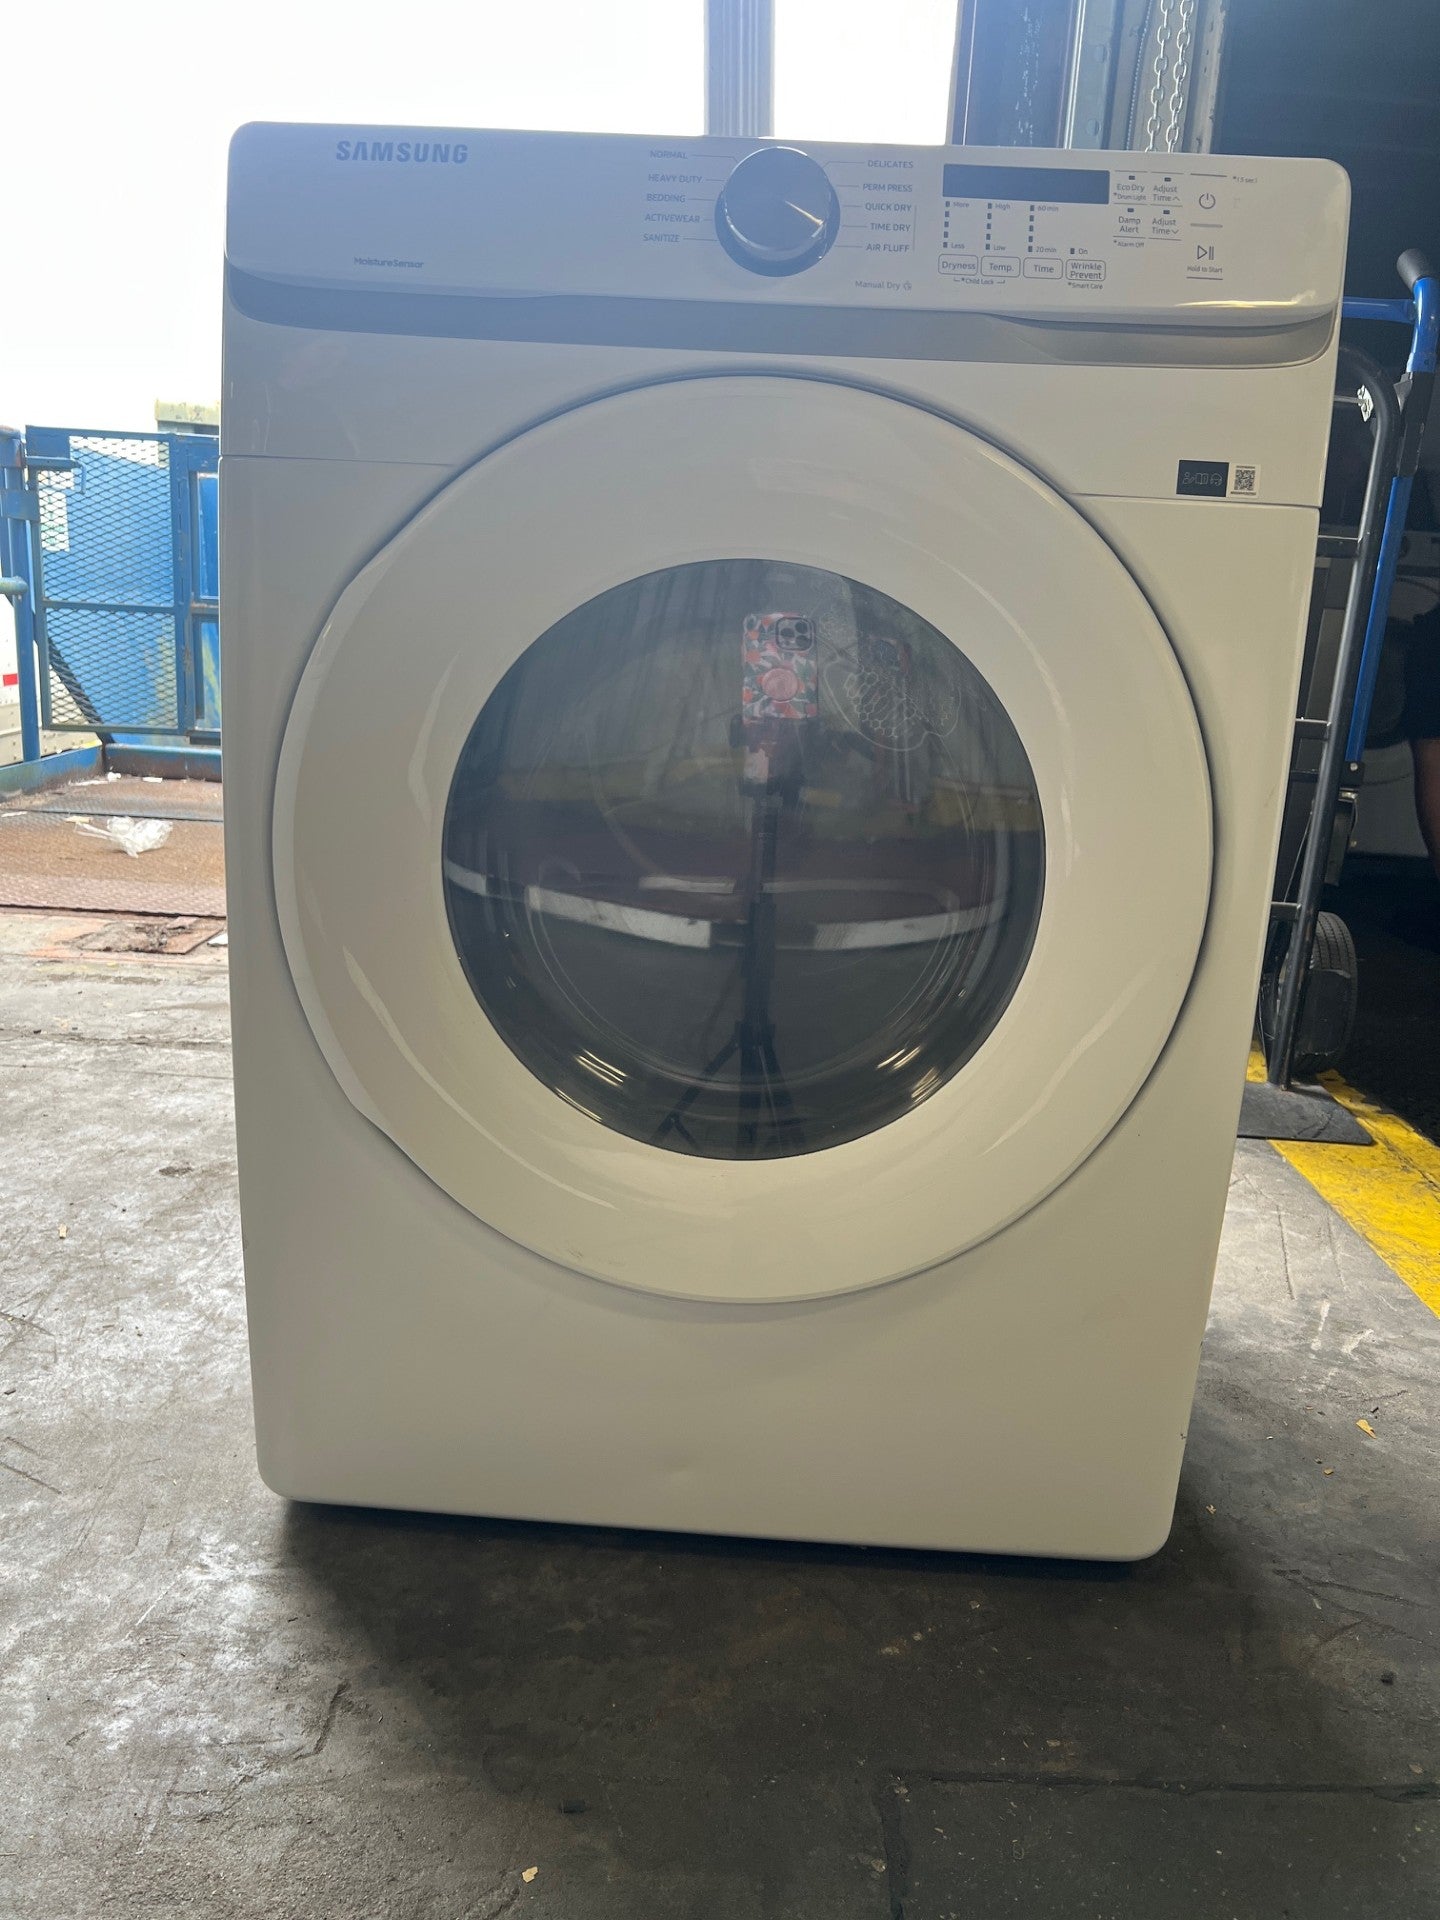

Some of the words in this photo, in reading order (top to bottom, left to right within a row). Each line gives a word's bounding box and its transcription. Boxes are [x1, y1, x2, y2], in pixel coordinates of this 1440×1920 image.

[336, 140, 468, 164] SAMSUNG
[650, 150, 688, 160] NORMAL
[867, 159, 914, 169] DELICATES
[648, 173, 677, 183] HEAVY
[679, 174, 703, 184] DUTY
[863, 183, 886, 192] PERM
[887, 183, 913, 193] PRESS
[1116, 183, 1131, 191] Eco
[1131, 183, 1145, 193] Dry
[1153, 185, 1177, 194] Adjust
[646, 193, 686, 203] BEDDING
[1153, 193, 1172, 202] Time
[865, 202, 892, 212] QUICK
[893, 203, 912, 212] DRY
[995, 203, 1011, 211] High
[645, 213, 700, 223] ACTIVEWEAR
[1118, 216, 1141, 225] Damp
[1152, 217, 1176, 226] Adjust
[870, 222, 891, 231] TIME
[893, 223, 911, 232] DRY
[1119, 225, 1139, 233] Alert
[1152, 226, 1171, 235] Time
[642, 233, 681, 243] SANITIZE
[866, 243, 881, 252] AIR
[883, 244, 910, 253] FLUFF
[951, 242, 965, 250] Less
[1035, 246, 1045, 254] 20
[941, 261, 976, 271] Dryness
[989, 263, 1015, 273] Temp.
[1034, 264, 1055, 274] Time
[1070, 262, 1103, 271] Wrinkle
[1208, 266, 1223, 274] Start
[1070, 270, 1103, 281] Prevent
[855, 280, 885, 290] Manual
[886, 281, 901, 292] Dry
[980, 278, 994, 286] Lock
[1071, 282, 1090, 290] Smart
